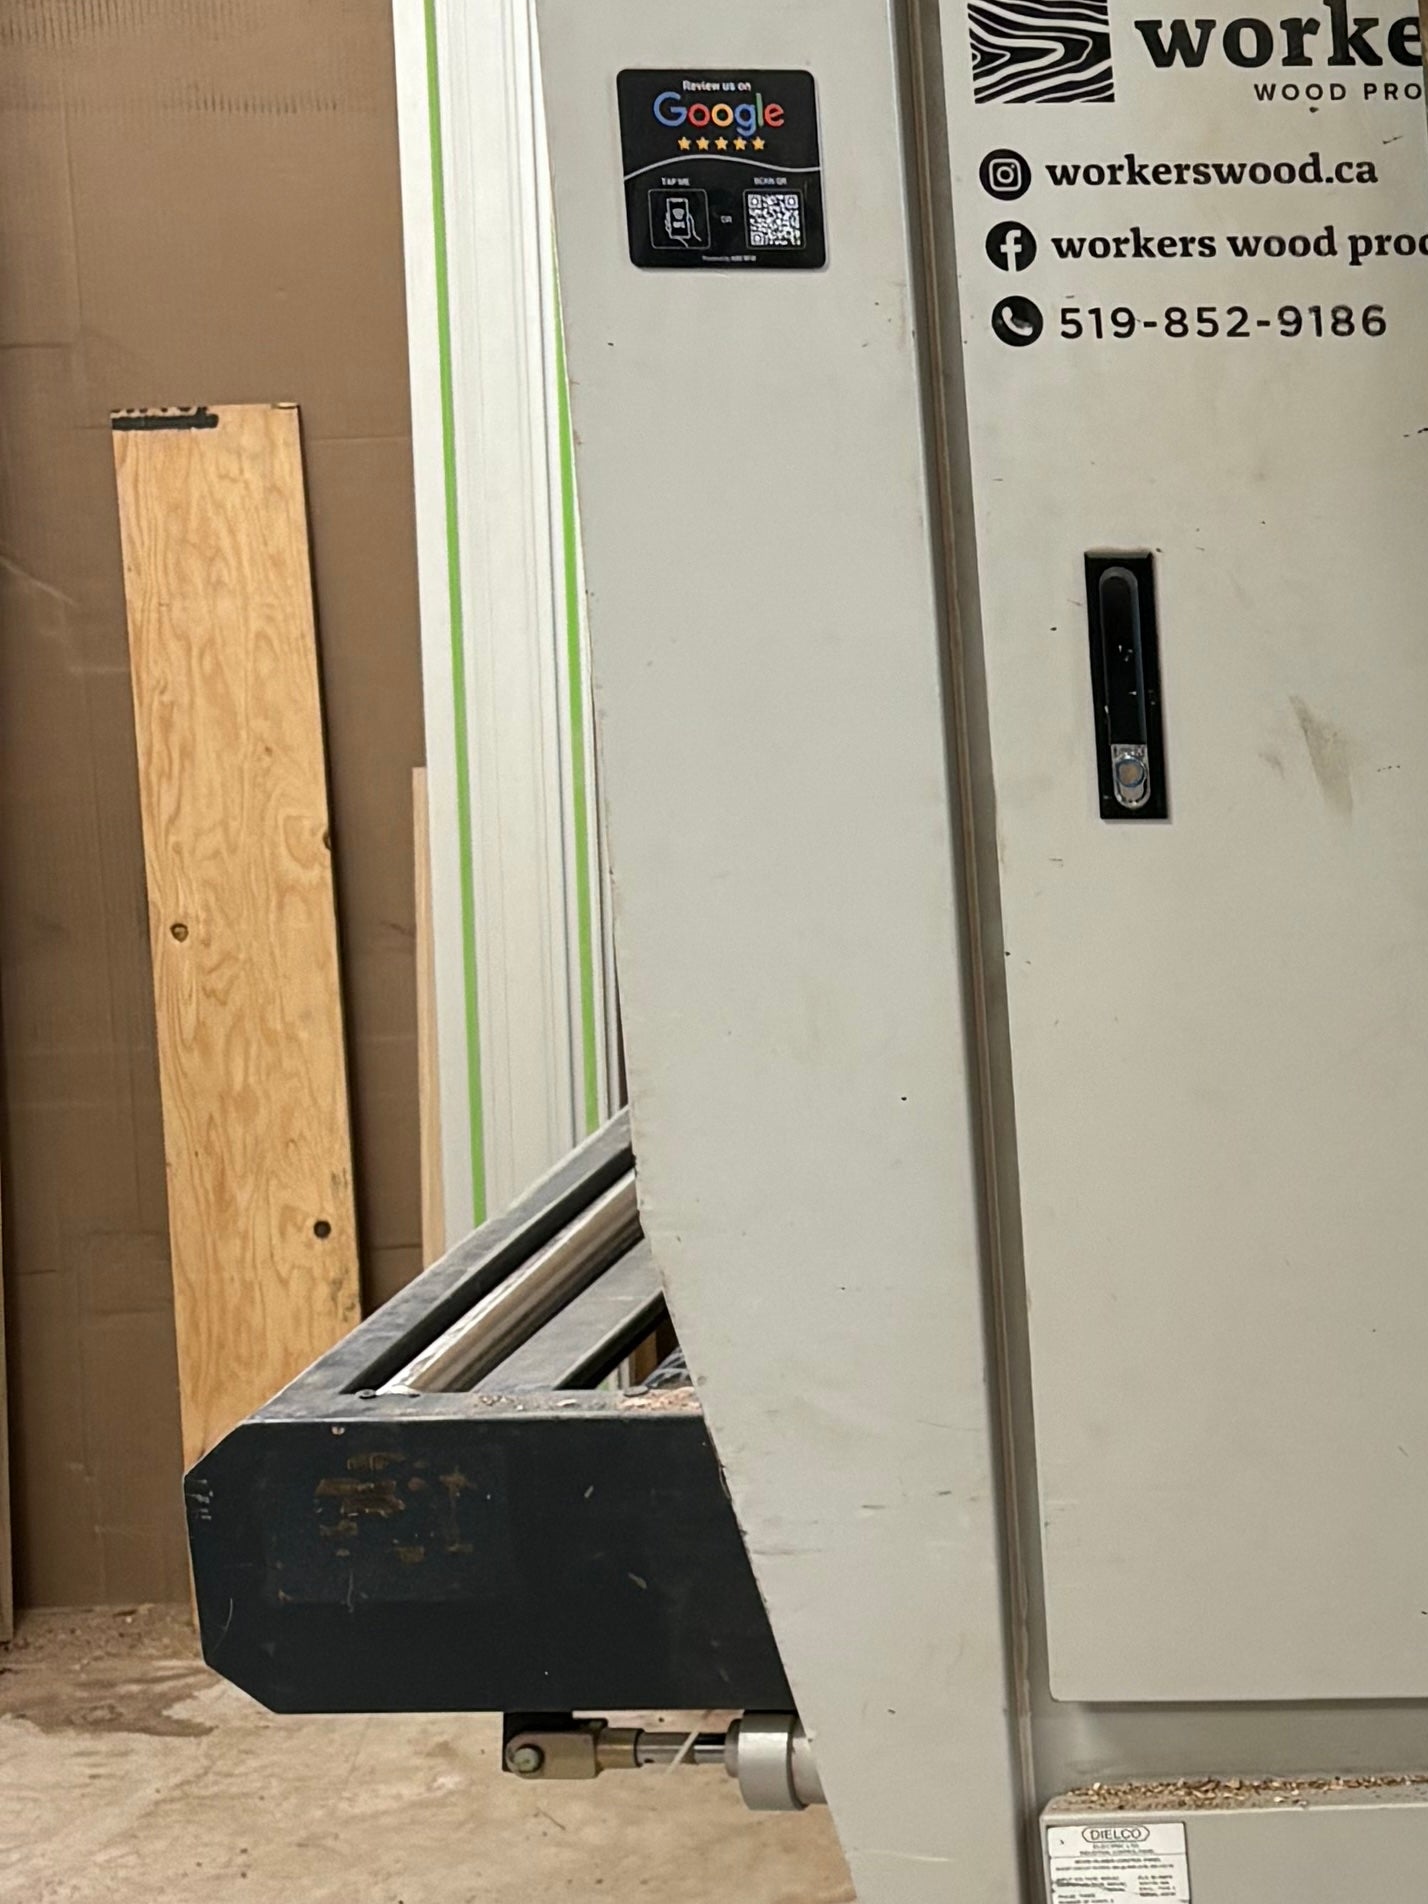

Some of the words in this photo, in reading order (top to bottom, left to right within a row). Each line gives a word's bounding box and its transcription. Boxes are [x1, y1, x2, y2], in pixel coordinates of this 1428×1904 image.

[682, 80, 720, 92] Review
[721, 82, 736, 92] us
[1254, 82, 1347, 101] WOOD
[1363, 82, 1422, 101] PRO
[653, 91, 785, 136] Google
[1045, 152, 1378, 186] workerswood.ca
[1051, 227, 1217, 258] workers
[1226, 225, 1337, 257] wood
[1060, 303, 1387, 339] 519-852-9186
[1090, 1828, 1142, 1841] DIELCO
